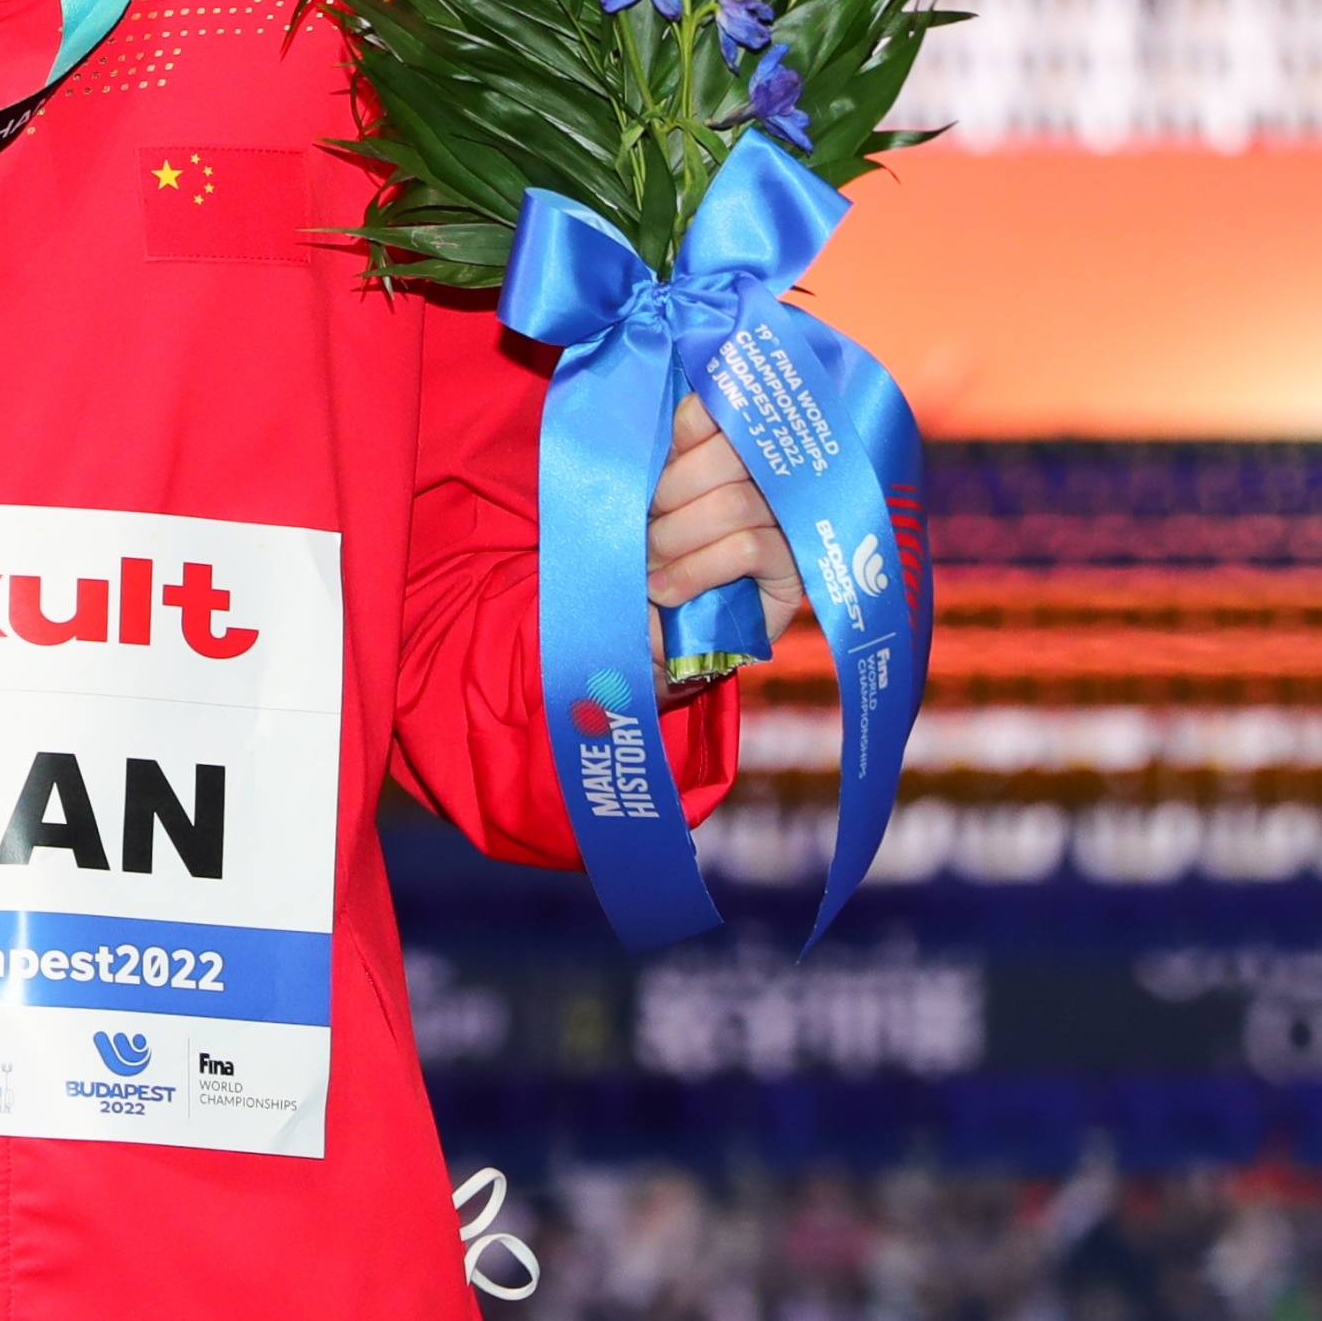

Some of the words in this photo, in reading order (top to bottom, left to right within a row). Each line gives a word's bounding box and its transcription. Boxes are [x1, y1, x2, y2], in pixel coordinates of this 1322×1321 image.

[712, 370, 749, 411] JUNE
[719, 341, 782, 423] BUDAPEST
[773, 426, 804, 467] 2022
[770, 349, 803, 391] FINA
[796, 389, 840, 456] WORLD
[749, 423, 765, 436] 3
[756, 438, 791, 476] JULY
[815, 519, 866, 632] BUDAPEST
[817, 556, 845, 606] 2022
[866, 654, 878, 711] WORLD
[876, 647, 891, 691] Fina
[857, 658, 874, 780] CHAMPIONSHIPS
[579, 743, 626, 817] MAKE
[604, 710, 660, 819] HISTORY
[198, 1052, 235, 1076] Fina
[65, 1081, 177, 1103] BUDAPEST
[99, 1100, 146, 1115] 2022
[198, 1079, 243, 1094] WORLD
[198, 1093, 298, 1111] CHAMPIONSHIPS
